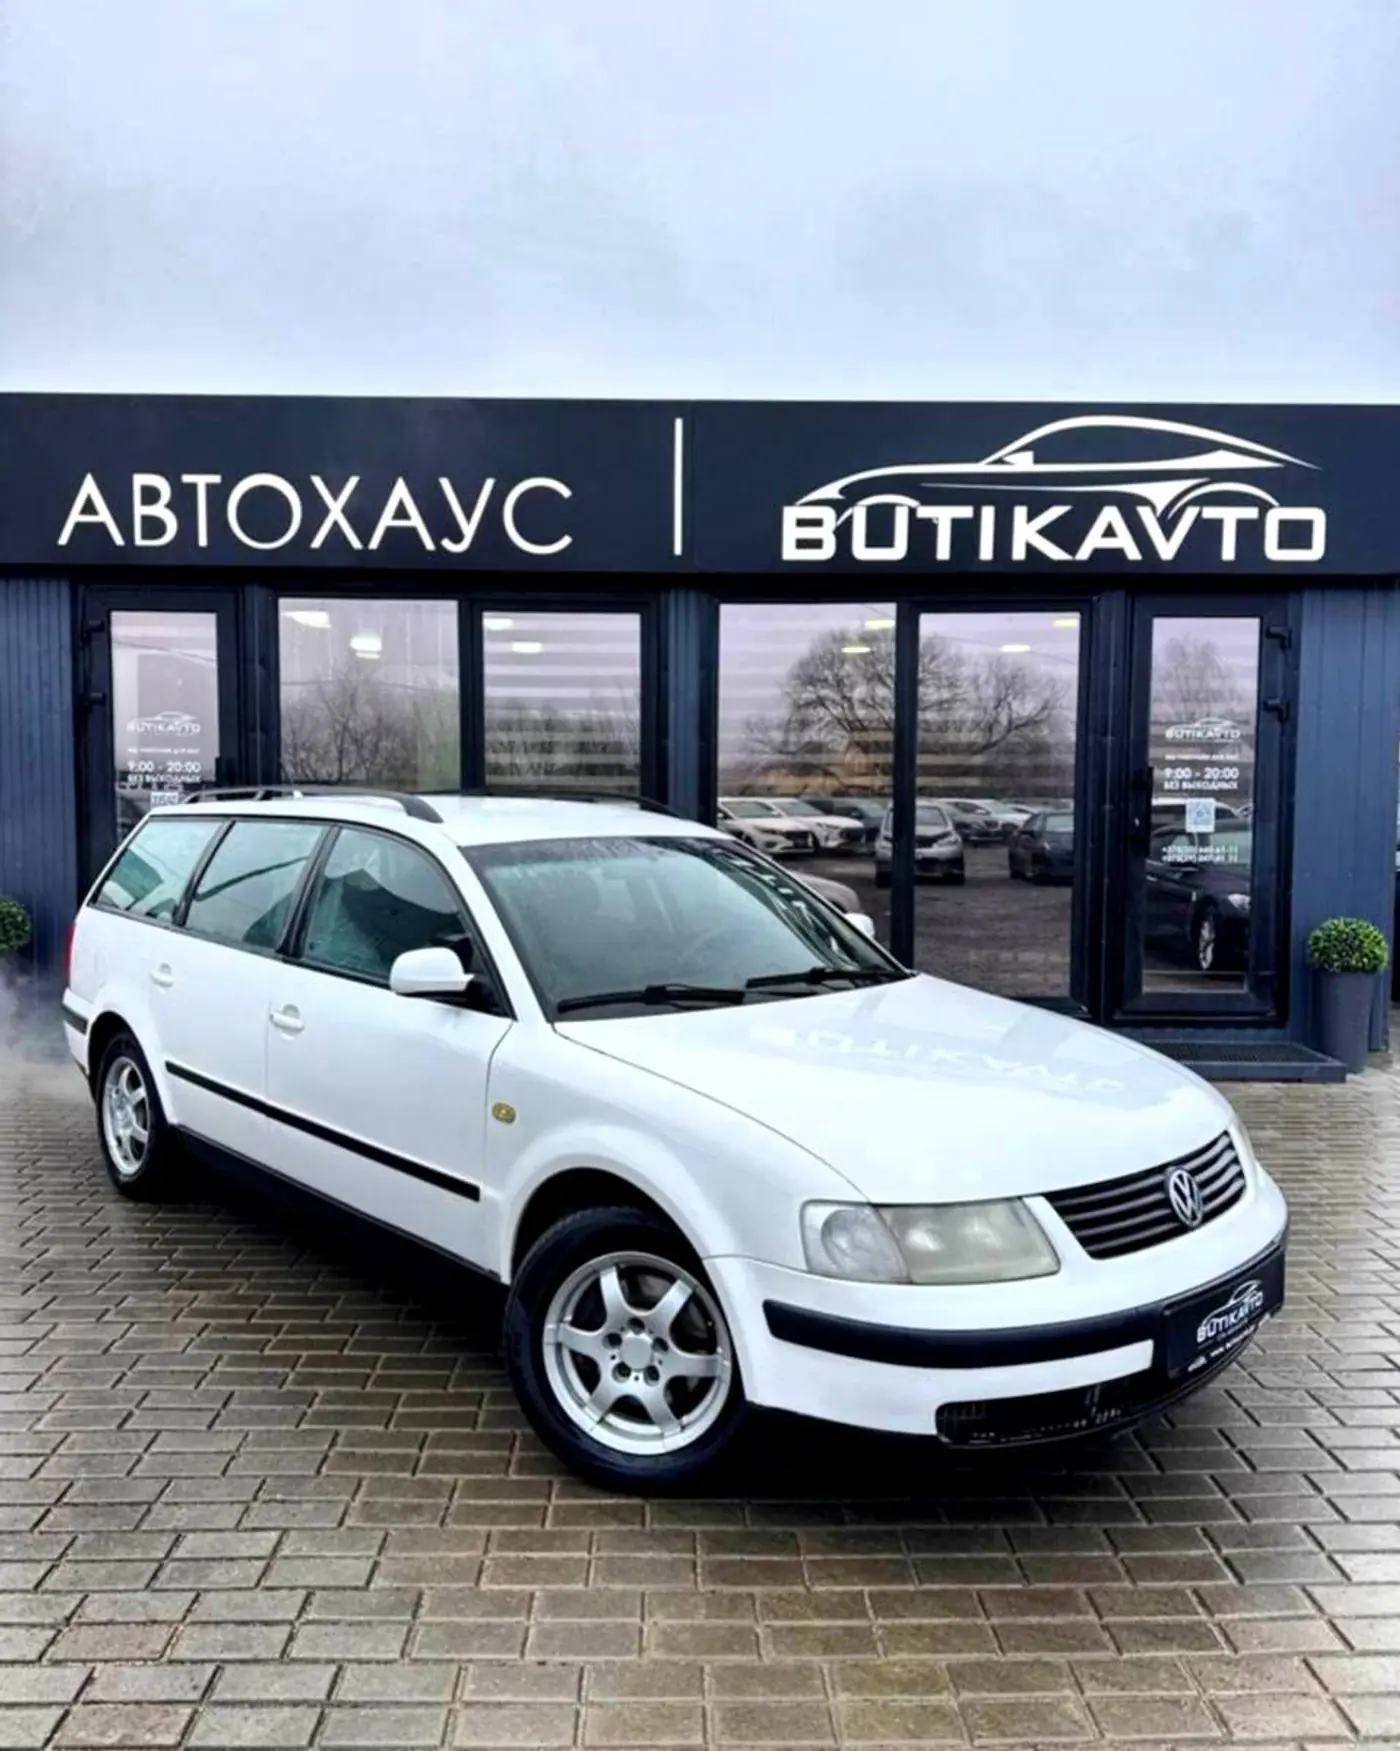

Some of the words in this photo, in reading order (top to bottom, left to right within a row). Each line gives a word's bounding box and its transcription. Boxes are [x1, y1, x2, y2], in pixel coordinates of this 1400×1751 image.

[57, 472, 573, 555] АВТОХАУС
[782, 504, 1326, 562] BUTIKAVTO
[1165, 728, 1241, 739] BUTIKAVTO
[166, 760, 202, 773] 20:00
[1164, 767, 1192, 779] 9:00
[1203, 767, 1240, 779] 20:00
[1196, 1290, 1264, 1343] BUTIKAVTO
